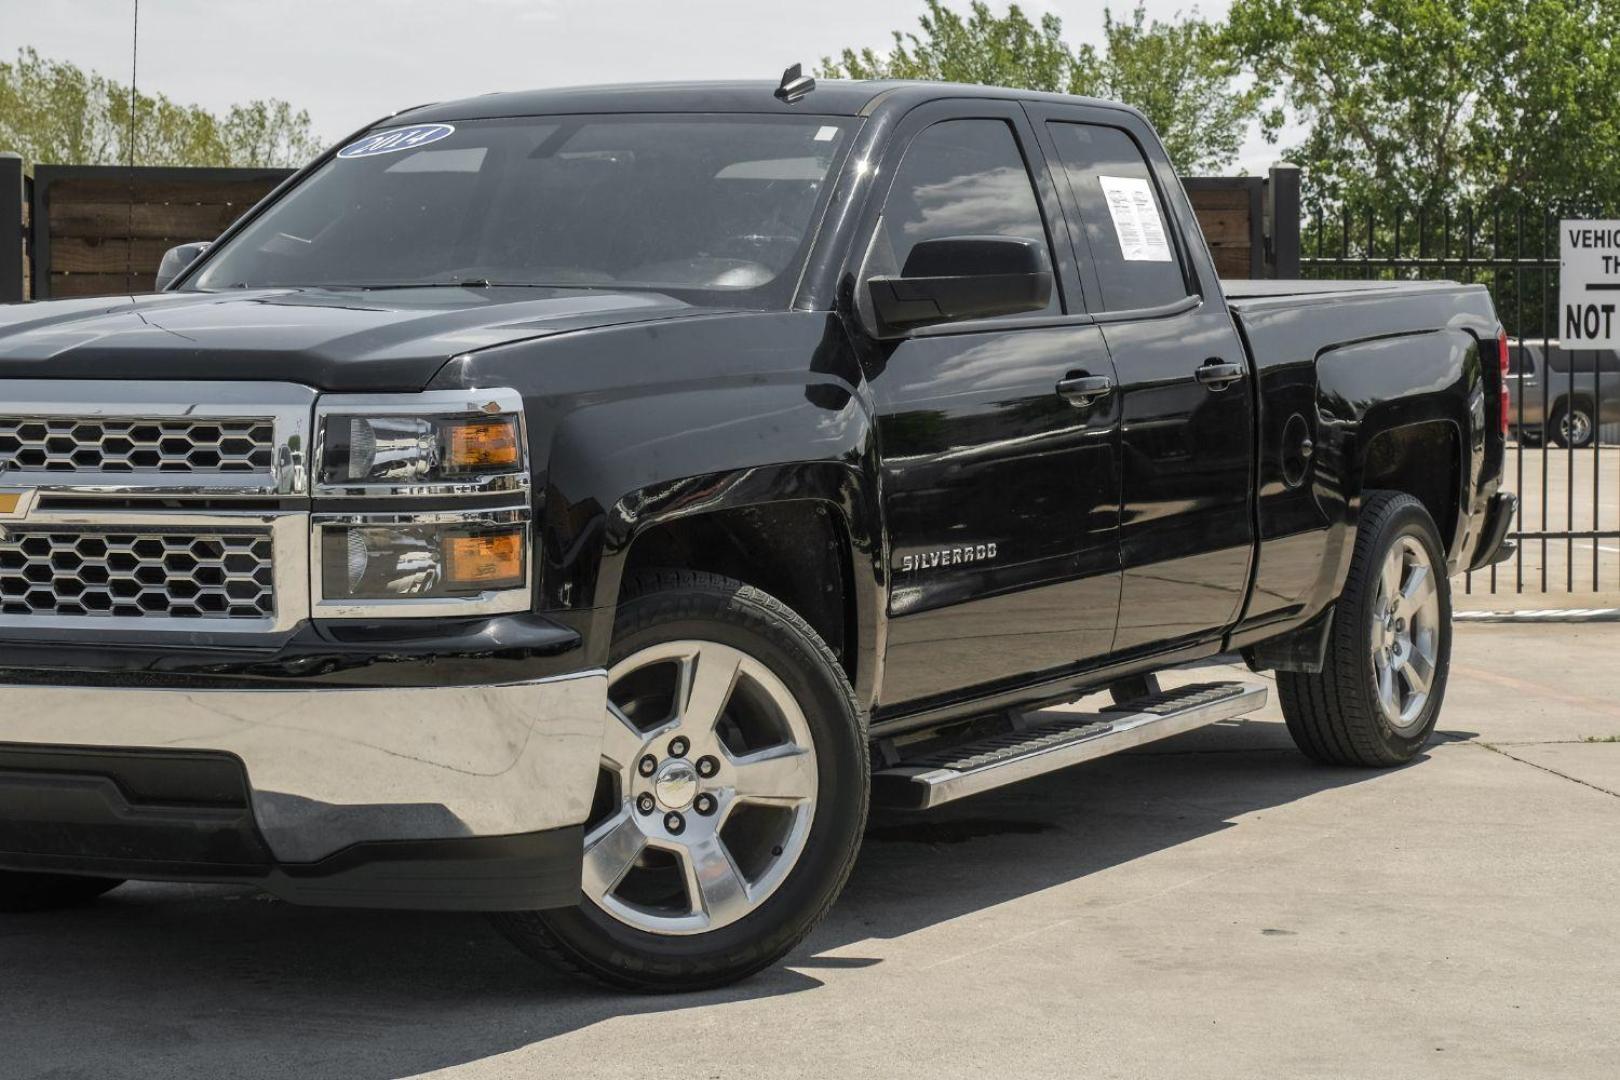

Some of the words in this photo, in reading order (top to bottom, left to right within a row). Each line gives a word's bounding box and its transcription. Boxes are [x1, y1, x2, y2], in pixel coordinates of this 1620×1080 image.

[348, 126, 443, 155] 2014
[1566, 303, 1616, 339] NOT
[902, 542, 997, 572] SILVERADO
